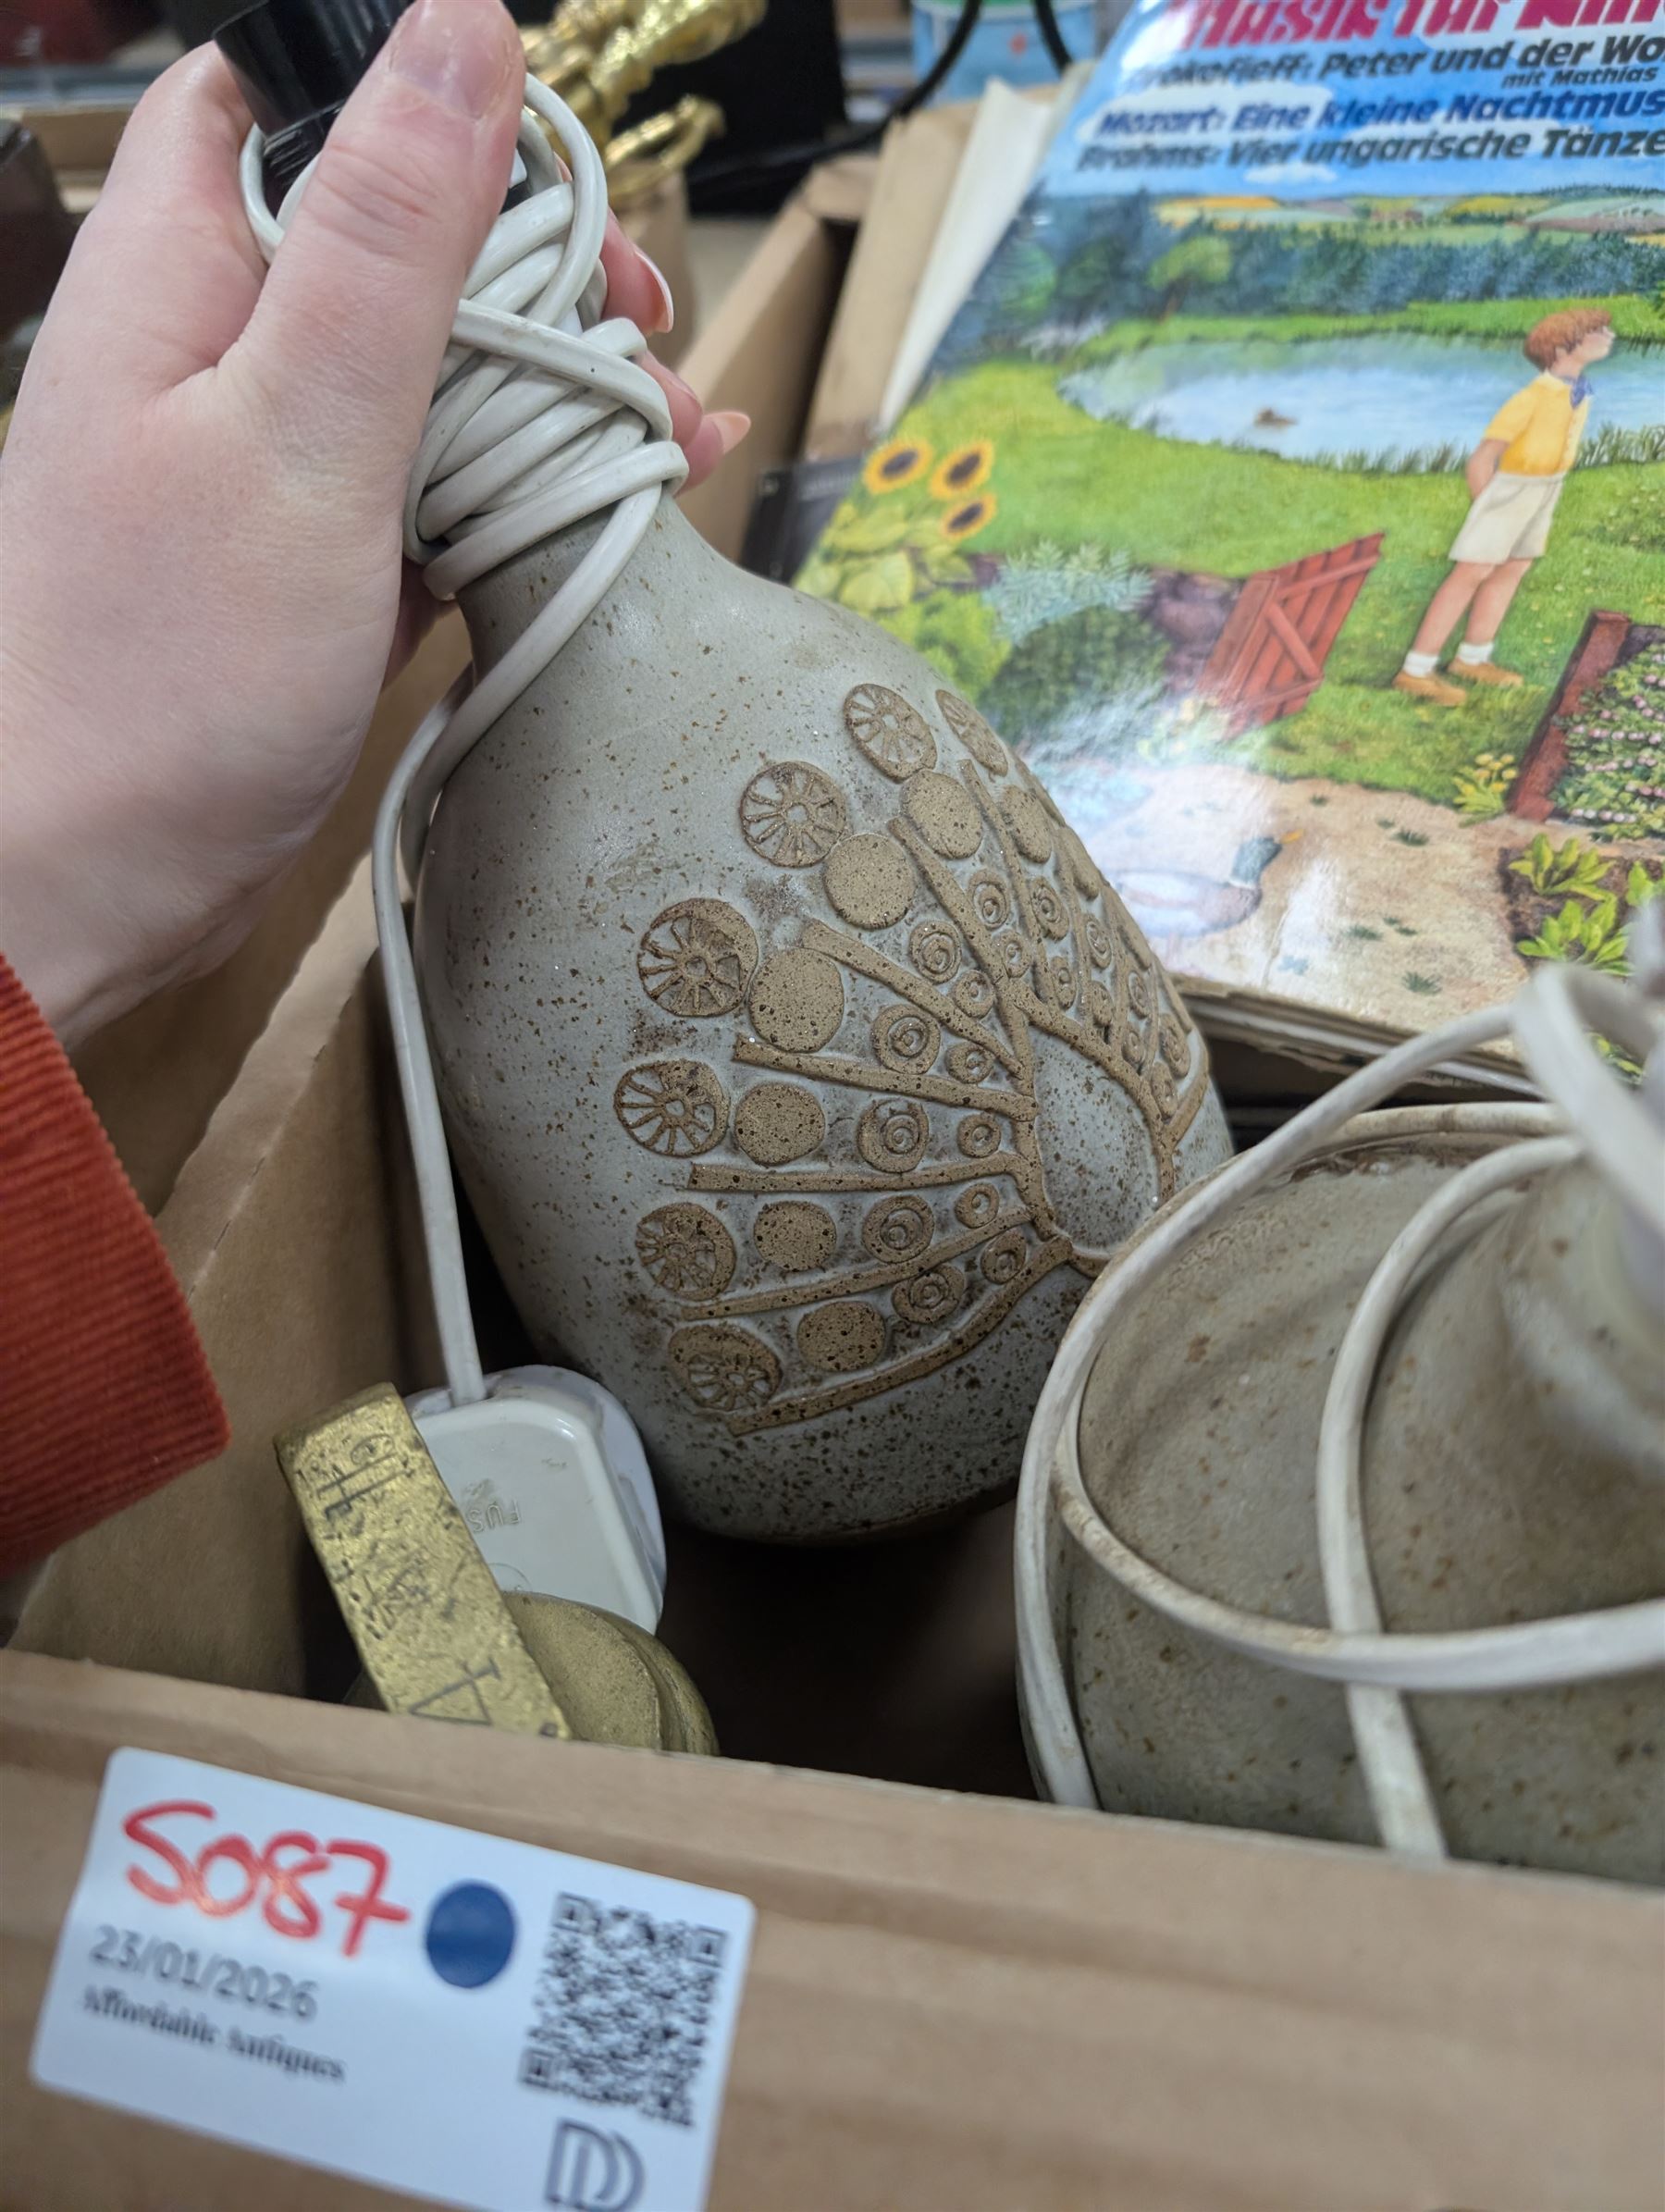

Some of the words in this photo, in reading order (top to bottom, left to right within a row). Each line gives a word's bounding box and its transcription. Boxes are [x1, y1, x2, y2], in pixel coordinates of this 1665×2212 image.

[1515, 0, 1665, 31] Kin
[1317, 49, 1427, 80] Peter
[1429, 40, 1515, 74] und
[1517, 37, 1595, 69] der
[1599, 34, 1665, 66] Wo
[1500, 71, 1546, 90] mit
[1549, 66, 1659, 87] Mathias
[1096, 105, 1227, 136] Mozart:
[1230, 102, 1312, 132] Eine
[1313, 95, 1440, 129] kleine
[1227, 139, 1301, 167] Vier
[1301, 129, 1532, 169] ungarische
[1540, 125, 1665, 159] Tänze
[89, 1924, 319, 2025] 23/01/2026
